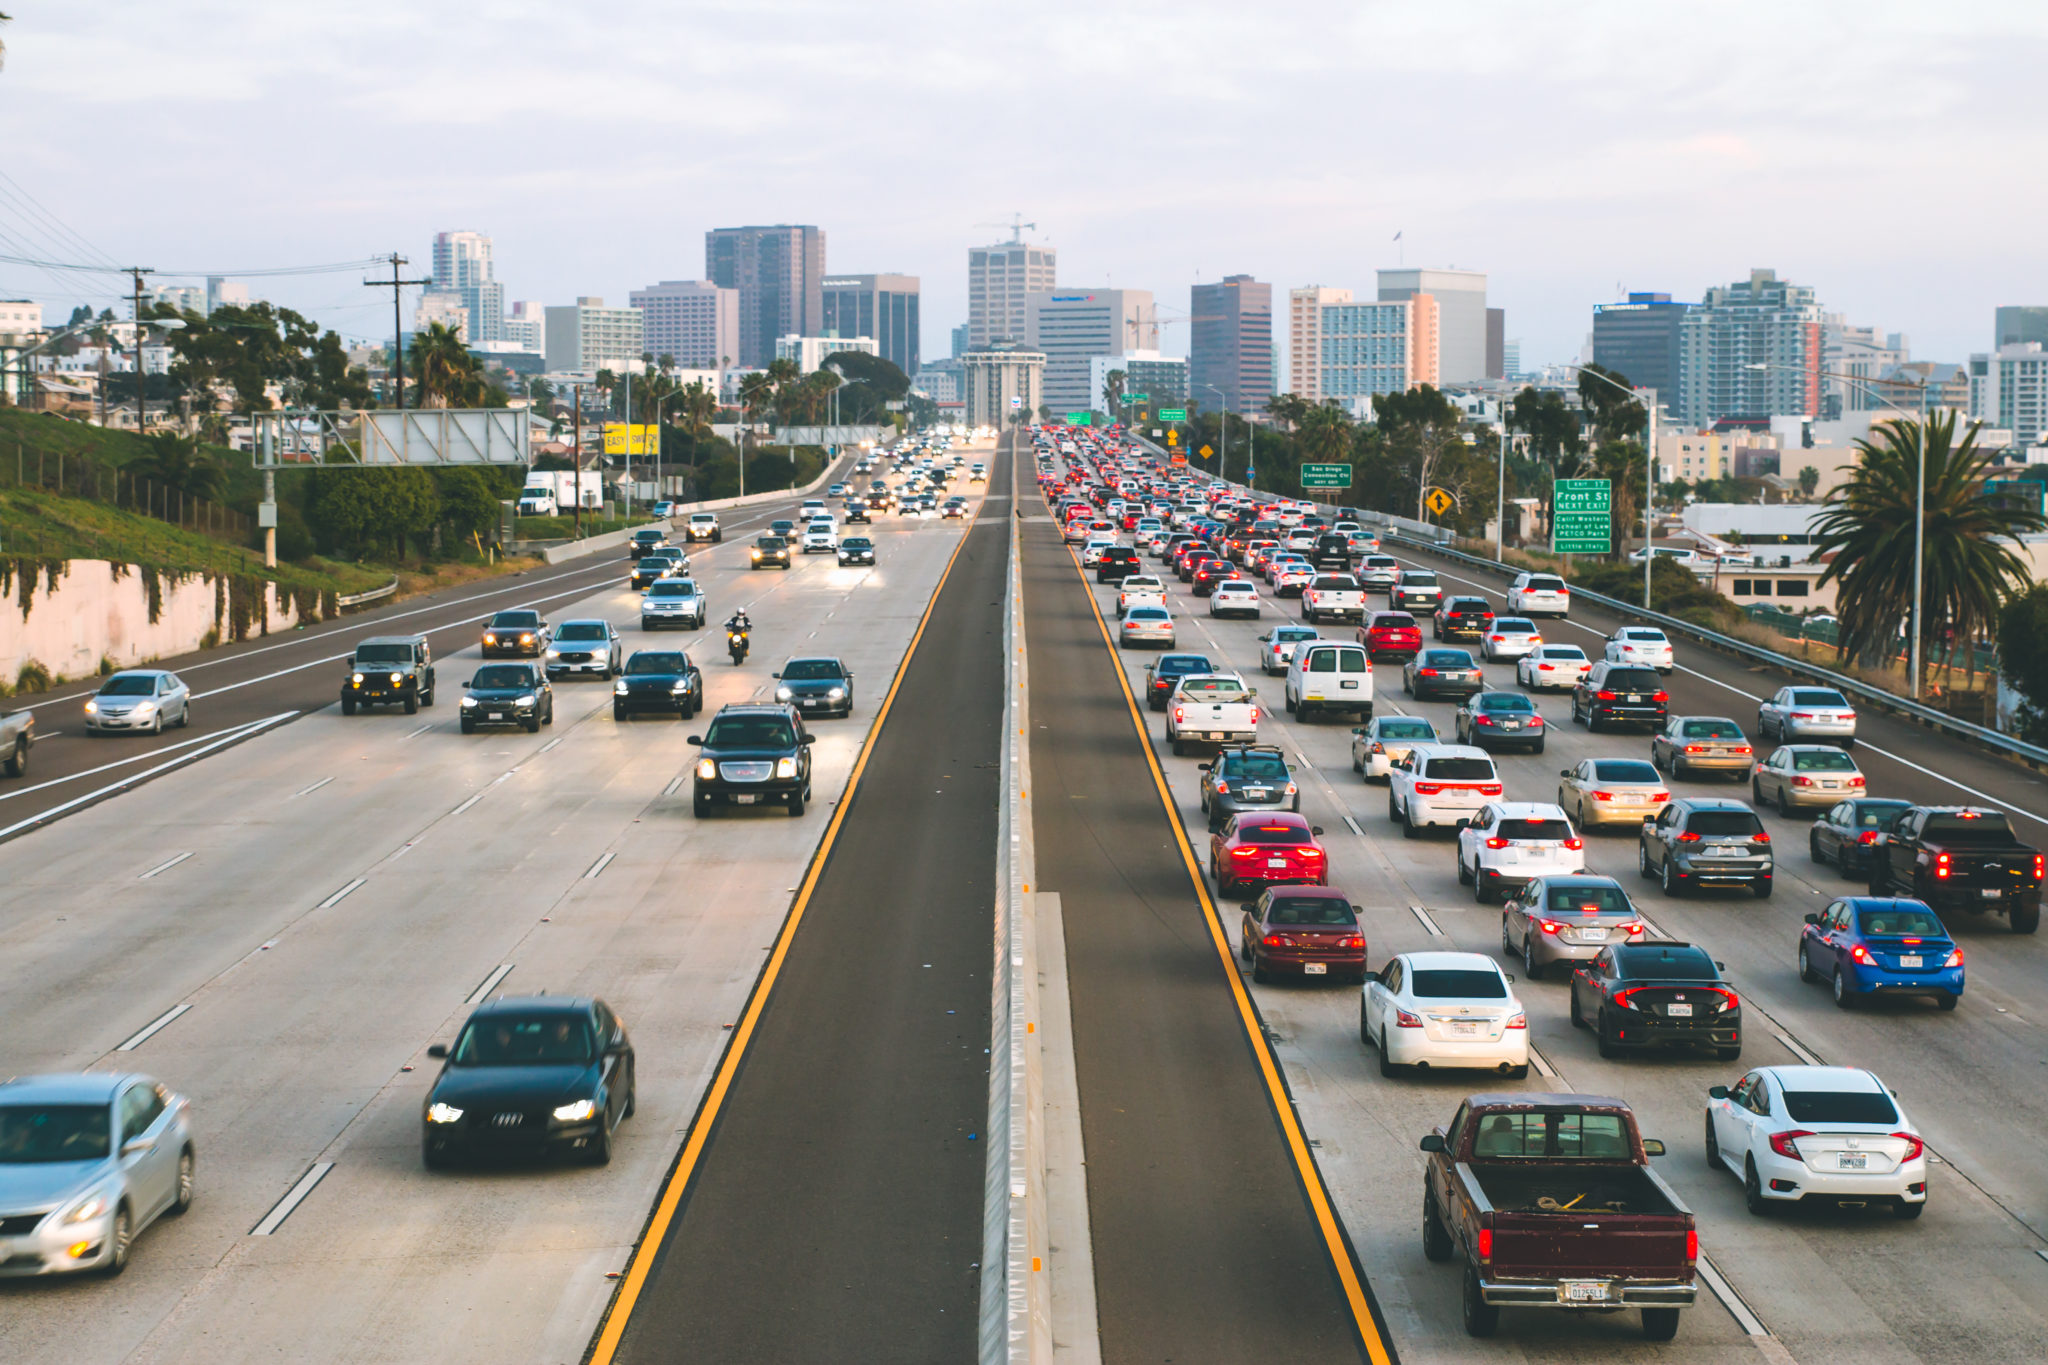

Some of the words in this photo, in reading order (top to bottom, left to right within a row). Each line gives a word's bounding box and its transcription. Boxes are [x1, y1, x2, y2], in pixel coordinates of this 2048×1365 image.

[607, 436, 625, 446] EASY
[1557, 492, 1590, 500] Front
[1595, 492, 1608, 500] St
